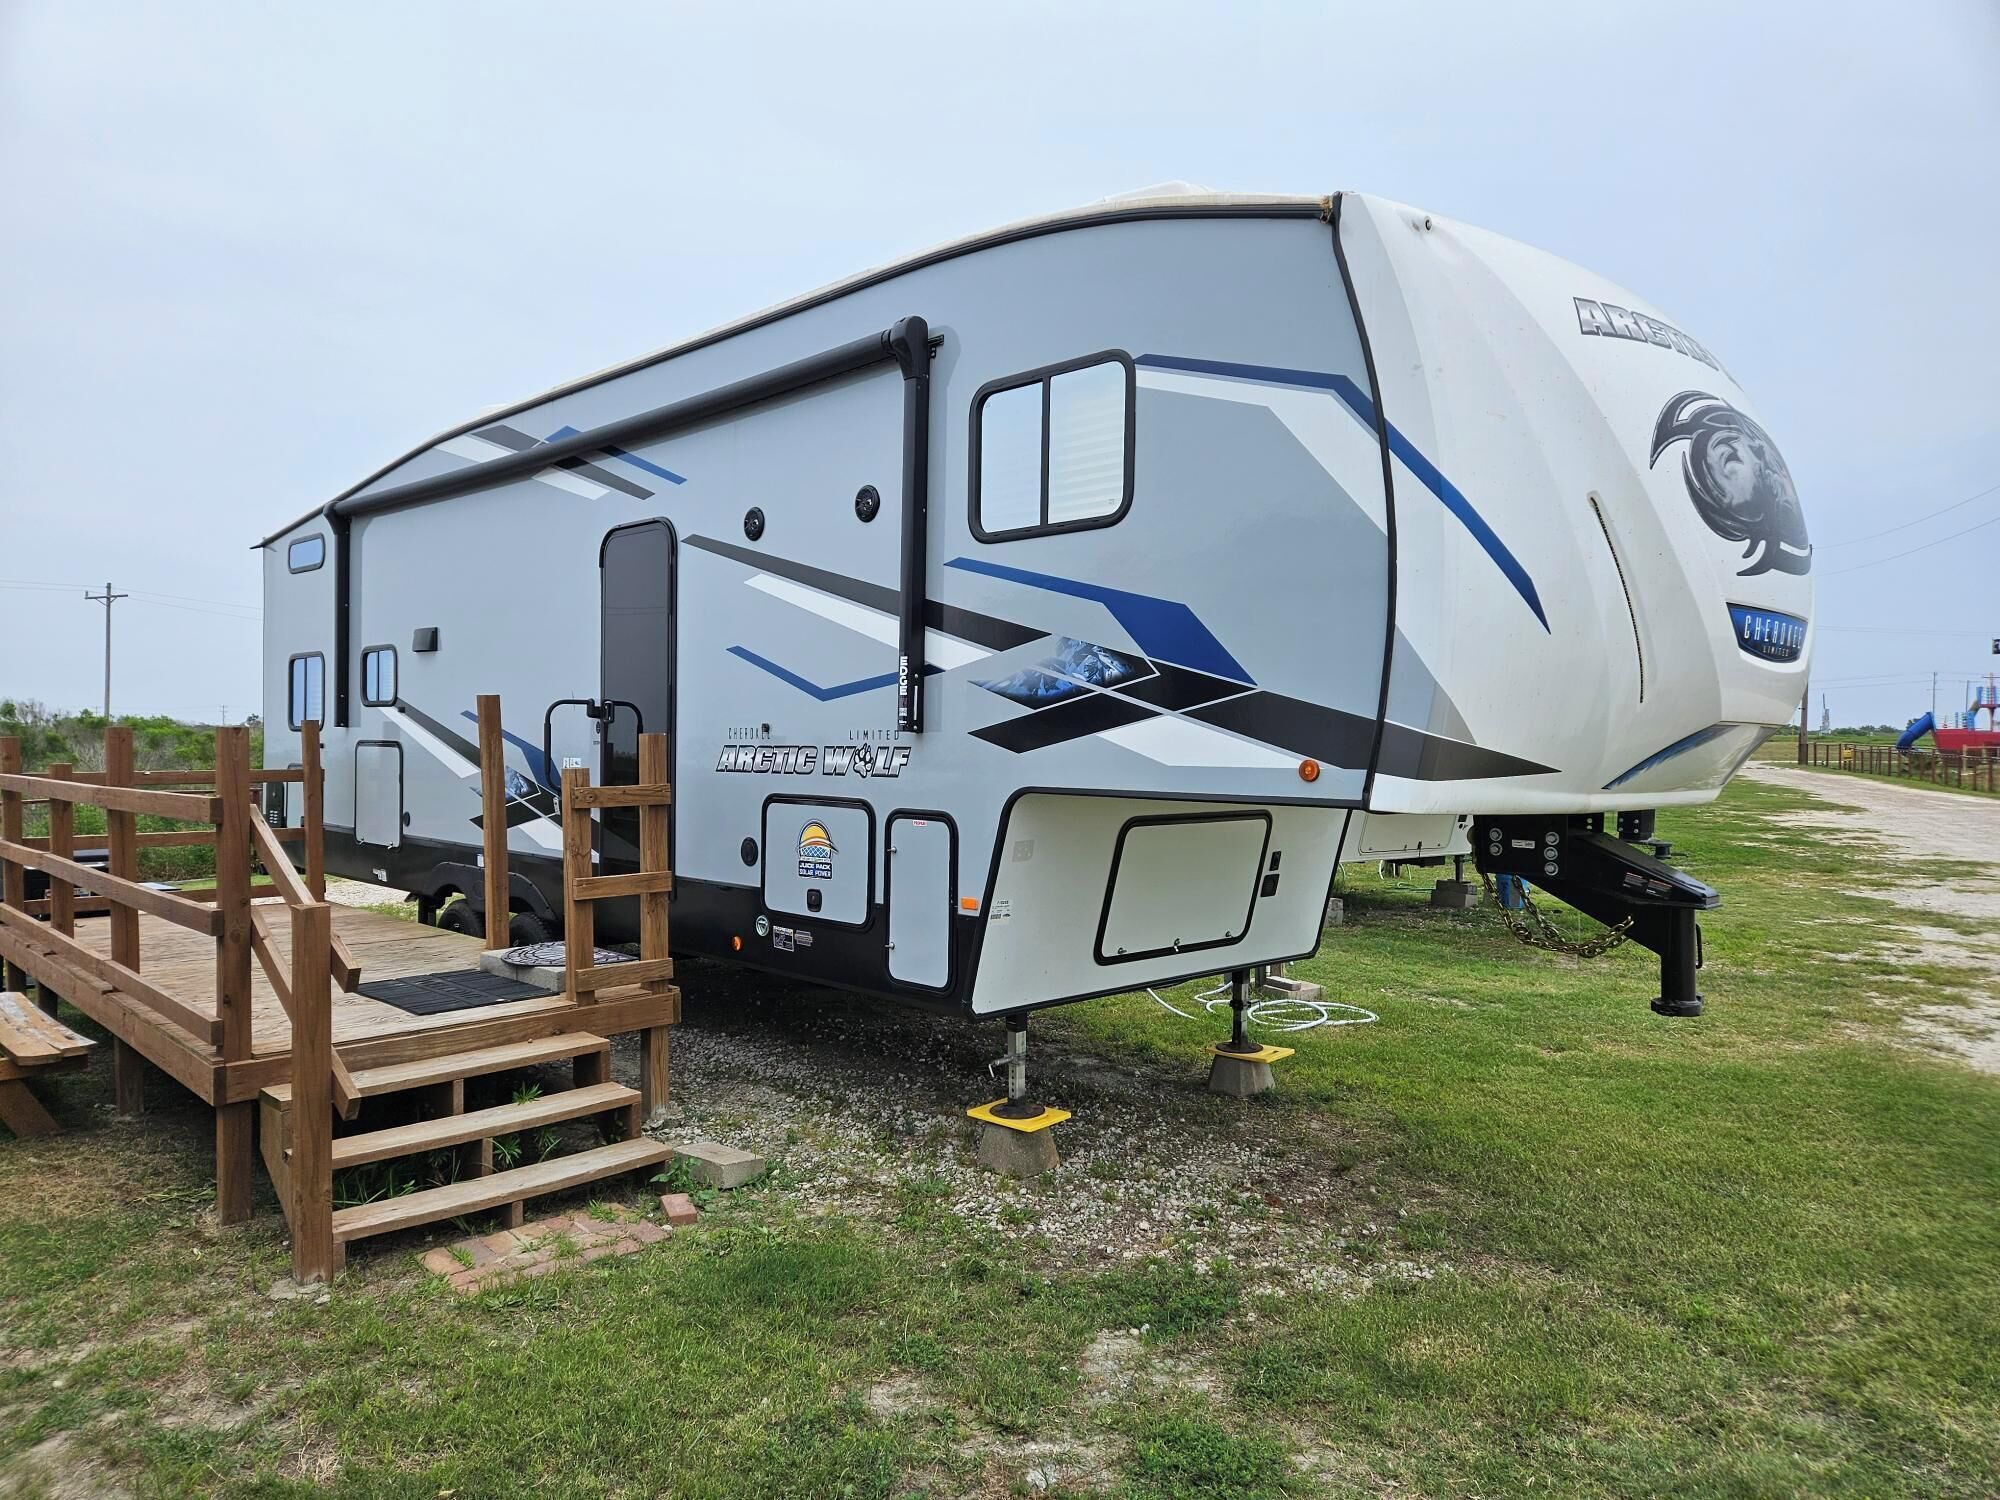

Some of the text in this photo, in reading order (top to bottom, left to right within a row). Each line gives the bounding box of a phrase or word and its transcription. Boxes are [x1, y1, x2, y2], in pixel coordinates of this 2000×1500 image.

[1743, 614, 1803, 649] CHEROKEE
[899, 656, 909, 696] EDGE
[849, 729, 900, 741] LIMITED
[716, 745, 818, 774] ARCTIC
